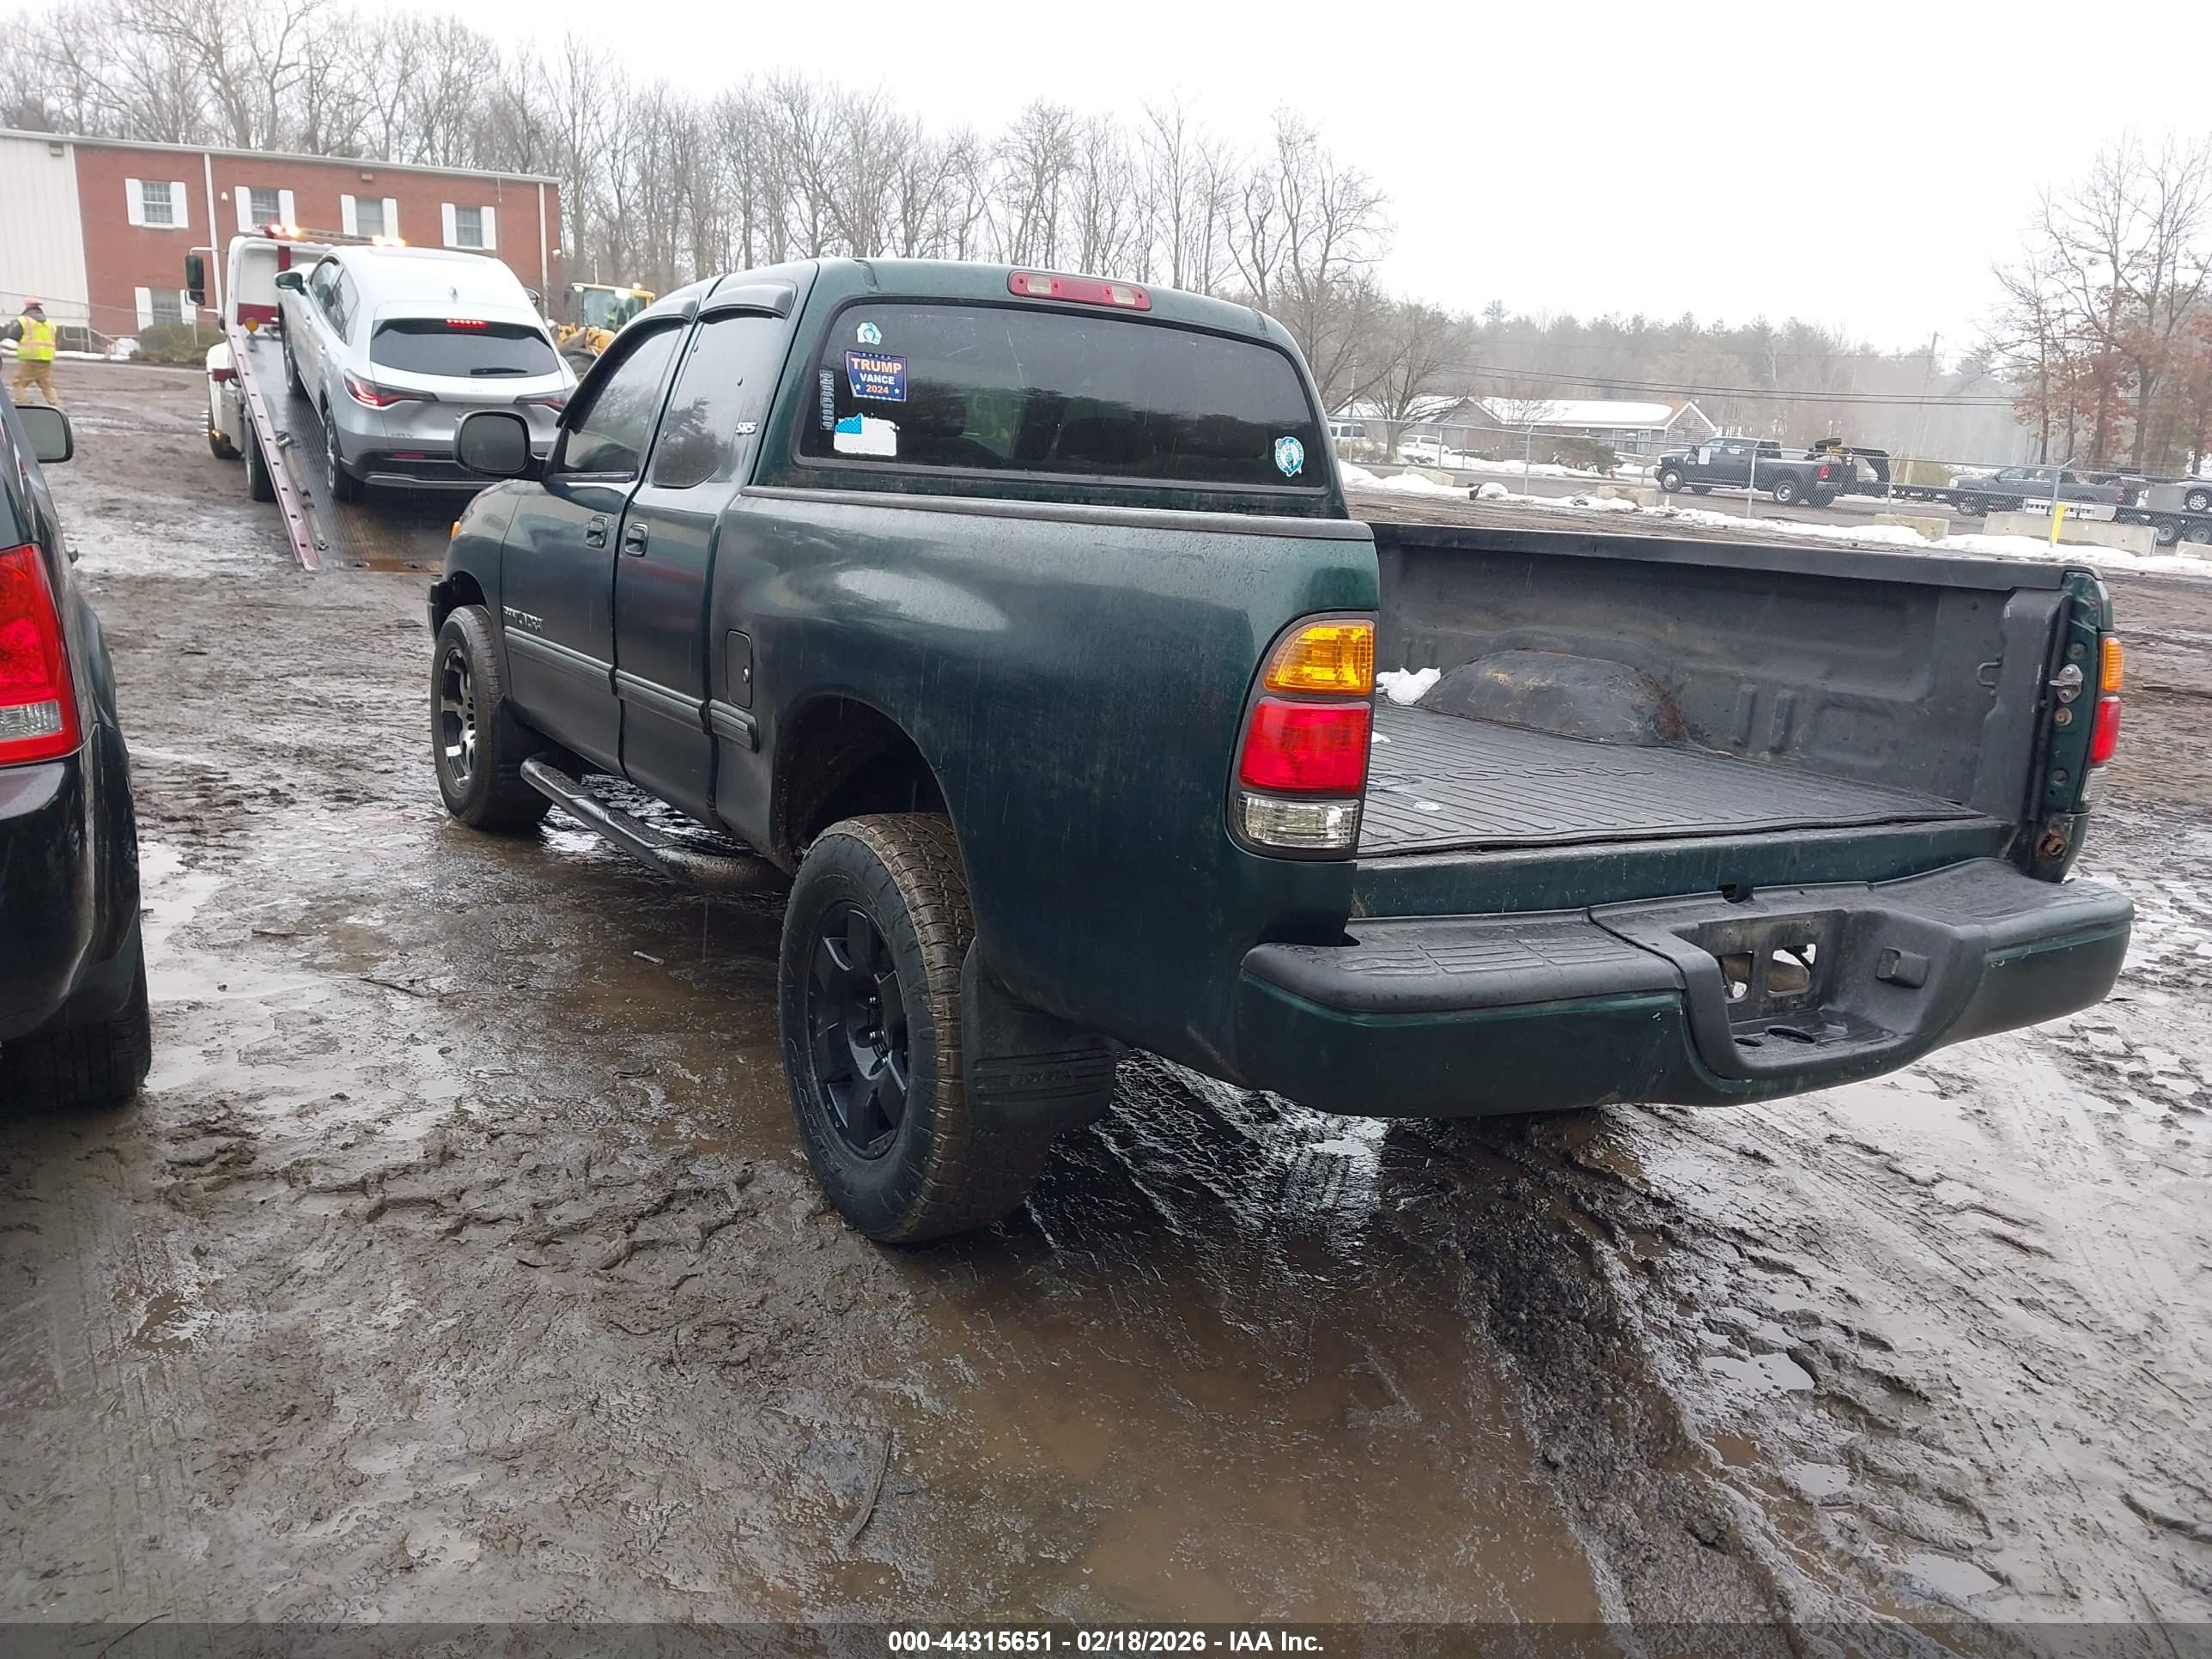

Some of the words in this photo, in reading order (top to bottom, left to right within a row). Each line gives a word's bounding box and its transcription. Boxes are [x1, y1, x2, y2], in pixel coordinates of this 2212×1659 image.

[851, 357, 902, 374] TRUMP
[860, 373, 896, 385] VANCE
[866, 384, 890, 394] 2024
